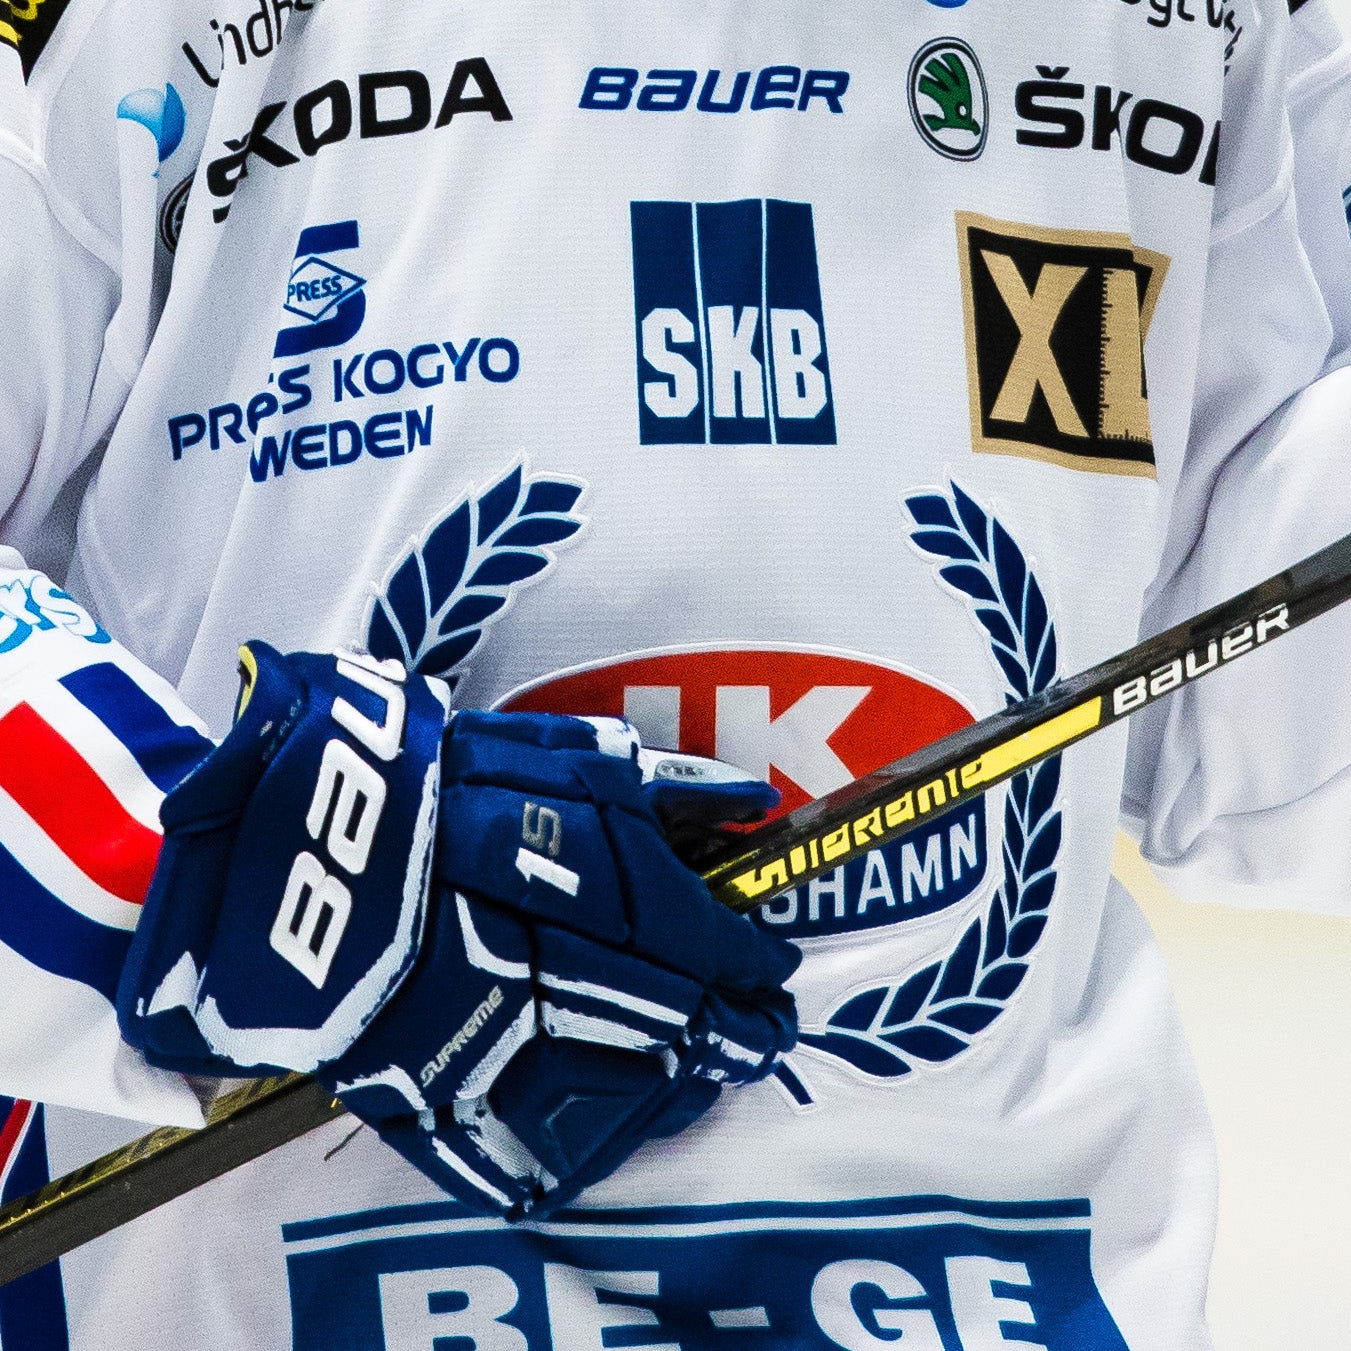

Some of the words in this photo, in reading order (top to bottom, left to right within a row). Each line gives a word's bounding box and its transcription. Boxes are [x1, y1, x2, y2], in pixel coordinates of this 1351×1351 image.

[1015, 65, 1222, 186] ŠKO
[287, 275, 343, 304] PRESS
[168, 364, 312, 461] PRES
[333, 337, 521, 403] KOGYO
[642, 306, 828, 418] SKB
[250, 405, 434, 483] WEDEN
[624, 685, 870, 808] IK
